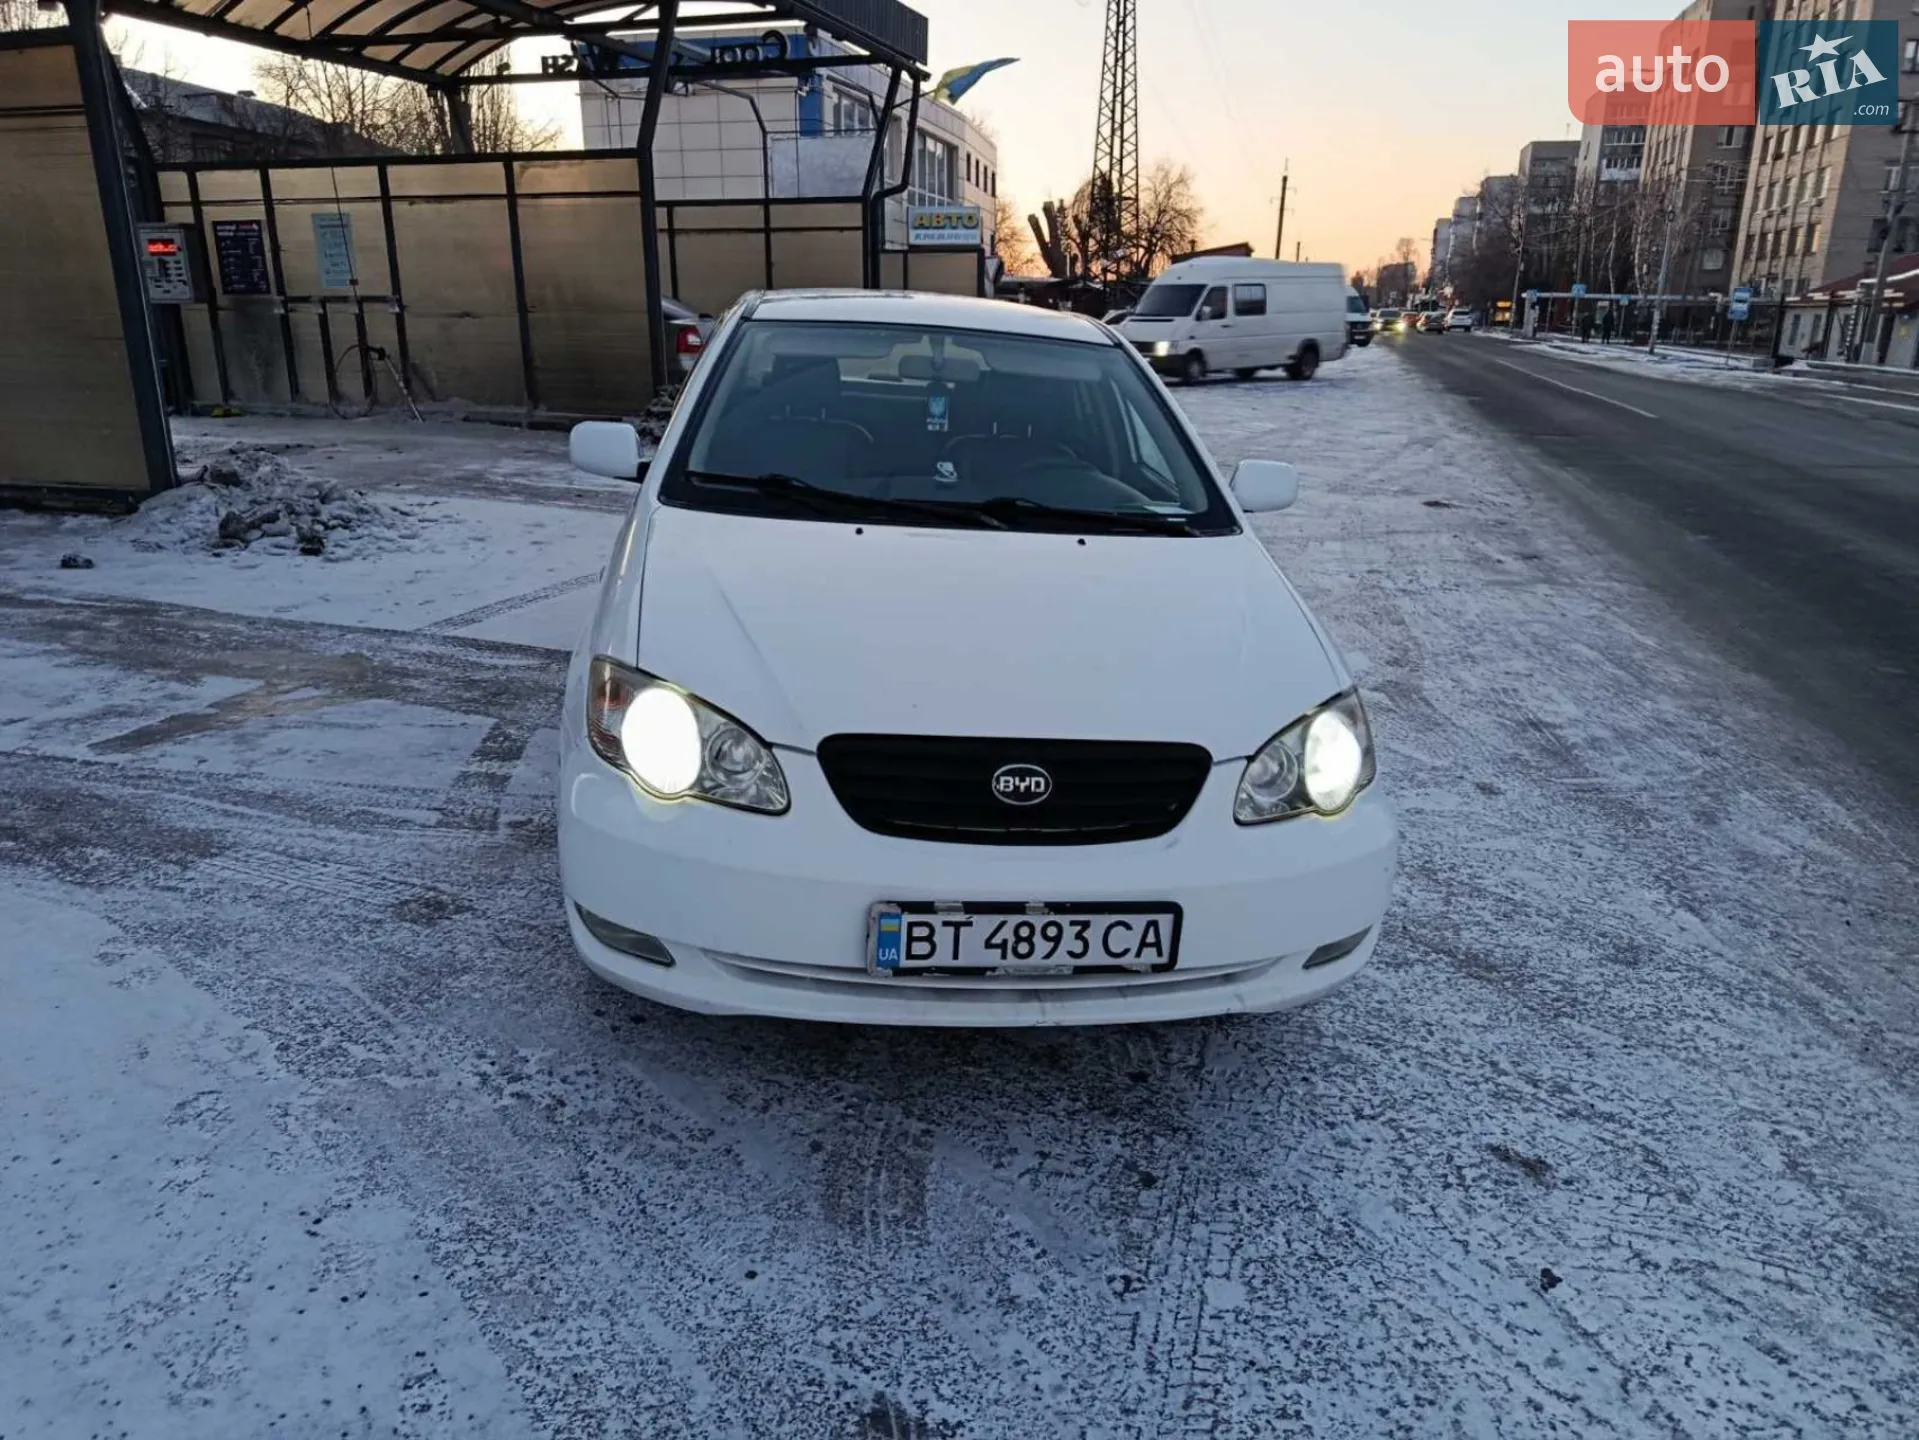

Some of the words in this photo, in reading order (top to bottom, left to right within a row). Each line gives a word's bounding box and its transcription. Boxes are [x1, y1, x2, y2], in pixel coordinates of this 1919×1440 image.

[913, 212, 979, 229] АВТО
[999, 775, 1046, 793] BYD
[904, 920, 973, 961] BT
[984, 919, 1091, 960] 4893
[1101, 918, 1164, 959] CA
[878, 947, 899, 961] UA
